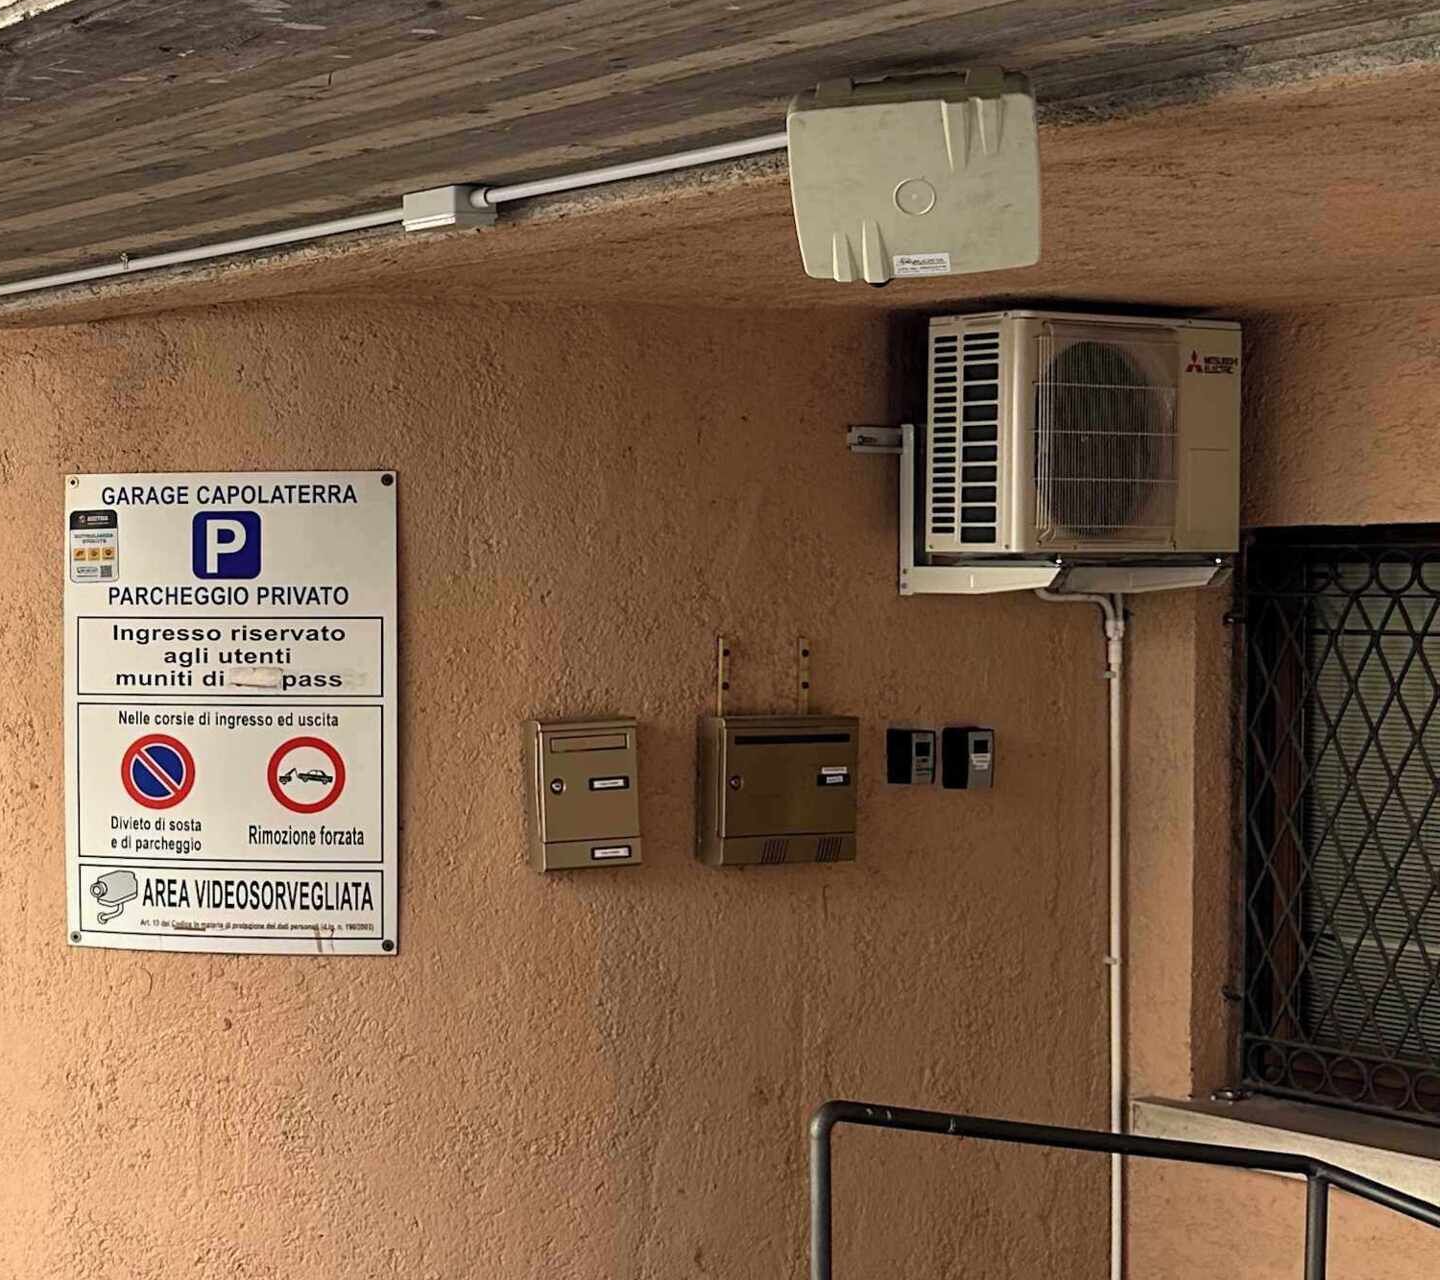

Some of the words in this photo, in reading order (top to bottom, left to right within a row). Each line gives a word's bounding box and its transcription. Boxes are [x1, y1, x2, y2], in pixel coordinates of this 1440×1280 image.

[101, 486, 189, 506] GARAGE
[196, 484, 358, 504] CAPOLATERRA
[206, 519, 247, 574] P
[108, 586, 249, 606] PARCHEGGIO
[256, 586, 350, 605] PRIVATO
[112, 624, 222, 645] Ingresso
[231, 625, 346, 642] riservato
[163, 648, 209, 668] agli
[218, 648, 292, 664] utenti
[115, 670, 193, 687] muniti
[202, 670, 225, 687] di
[281, 673, 343, 692] pass
[118, 710, 151, 726] Nelle
[154, 711, 195, 726] corsie
[198, 711, 211, 726] di
[215, 711, 273, 730] ingresso
[277, 712, 294, 727] ed
[298, 712, 339, 727] uscita
[110, 815, 152, 831] Divieto
[154, 816, 166, 831] di
[169, 818, 202, 832] sosta
[111, 838, 118, 849] e
[121, 835, 132, 849] di
[135, 836, 202, 855] parcheggio
[248, 824, 316, 846] Rimozione
[320, 825, 365, 846] forzata
[142, 878, 191, 908] AREA
[195, 879, 375, 911] VIDEOSORVEGLIATA
